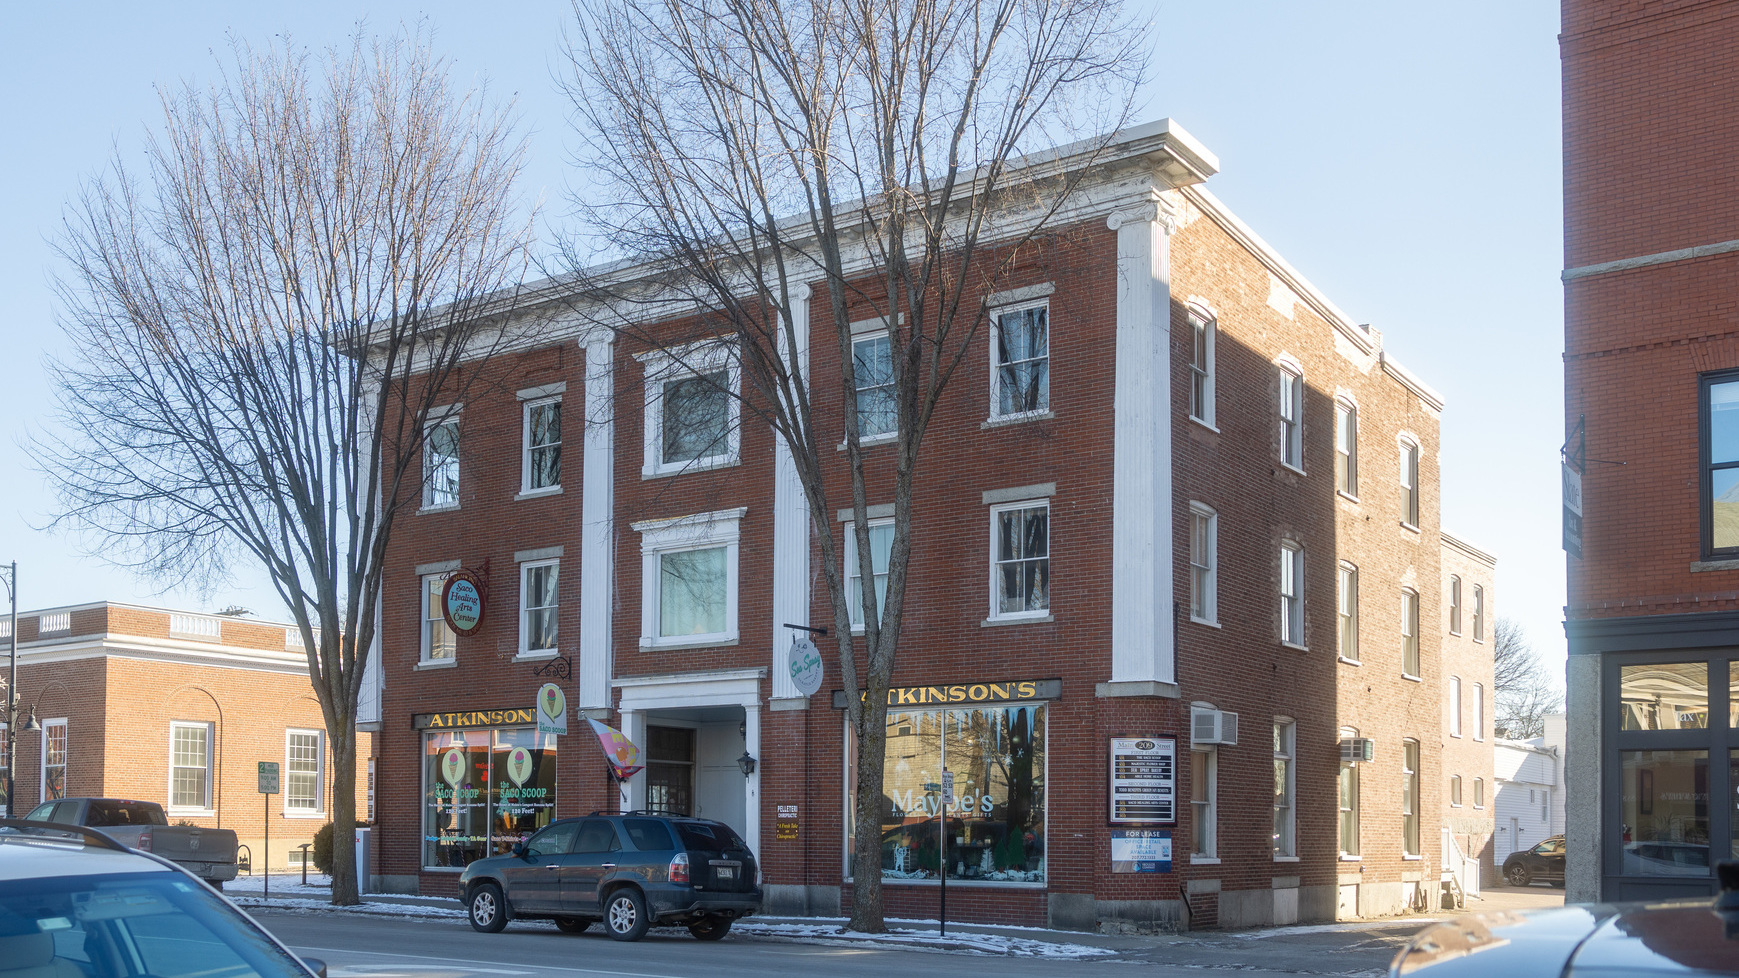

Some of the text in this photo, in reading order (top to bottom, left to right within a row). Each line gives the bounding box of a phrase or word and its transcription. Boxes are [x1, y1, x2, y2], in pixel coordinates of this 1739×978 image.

[456, 583, 473, 593] Saco
[450, 592, 478, 606] Healing
[456, 602, 472, 613] Arts
[453, 611, 477, 622] Center
[792, 654, 820, 678] Sea Spray
[861, 681, 1037, 705] TKINSON'S
[430, 709, 538, 728] ATKINSON'
[260, 763, 265, 772] 2
[435, 789, 479, 798] SACO SCOOP
[500, 788, 547, 798] SACO SCOOP
